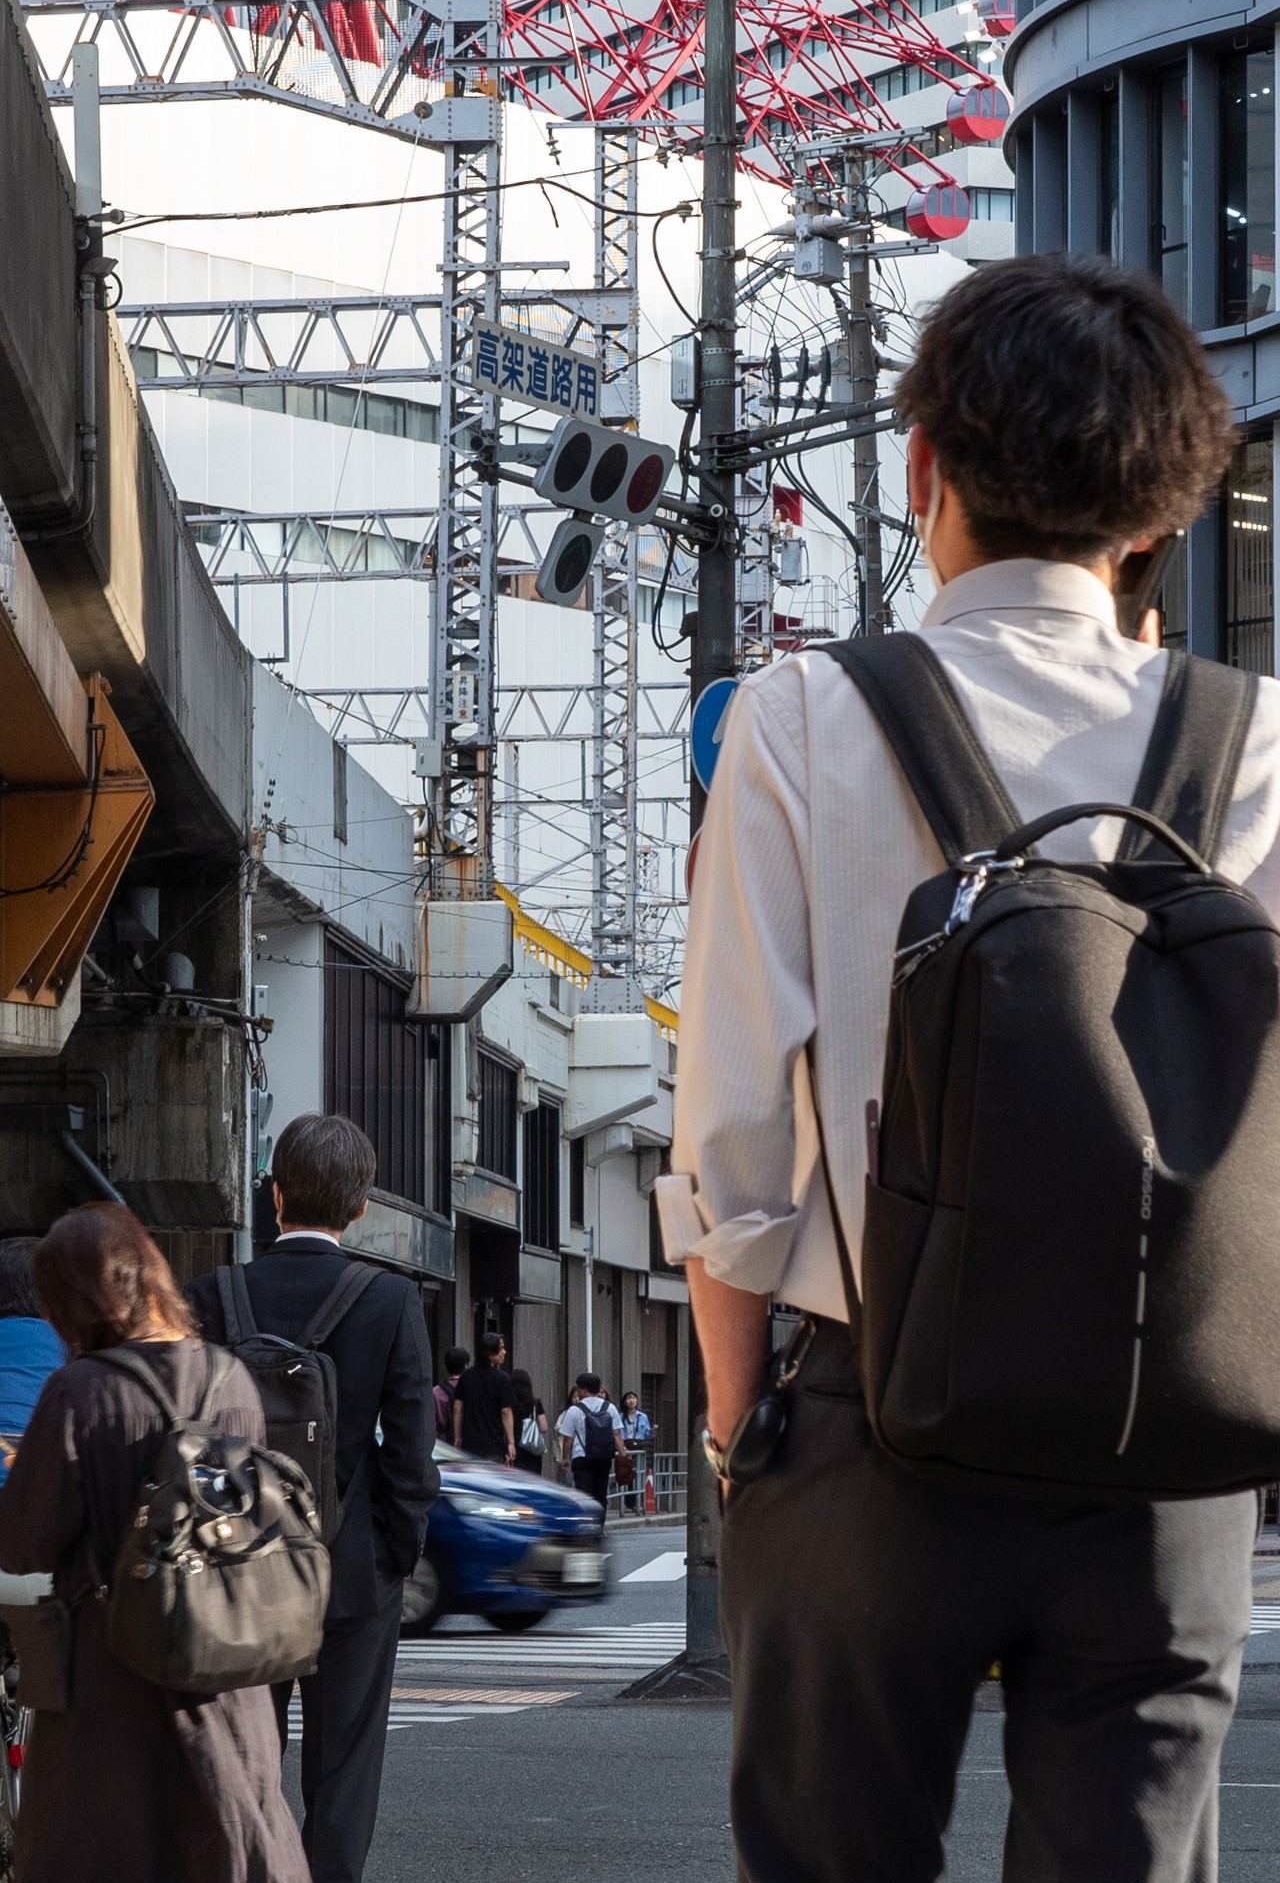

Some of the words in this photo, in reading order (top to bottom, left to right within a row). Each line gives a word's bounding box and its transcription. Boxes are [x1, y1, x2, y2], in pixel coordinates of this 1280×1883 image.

[475, 327, 599, 417] 高架道路用
[458, 676, 468, 720] 昇降注意
